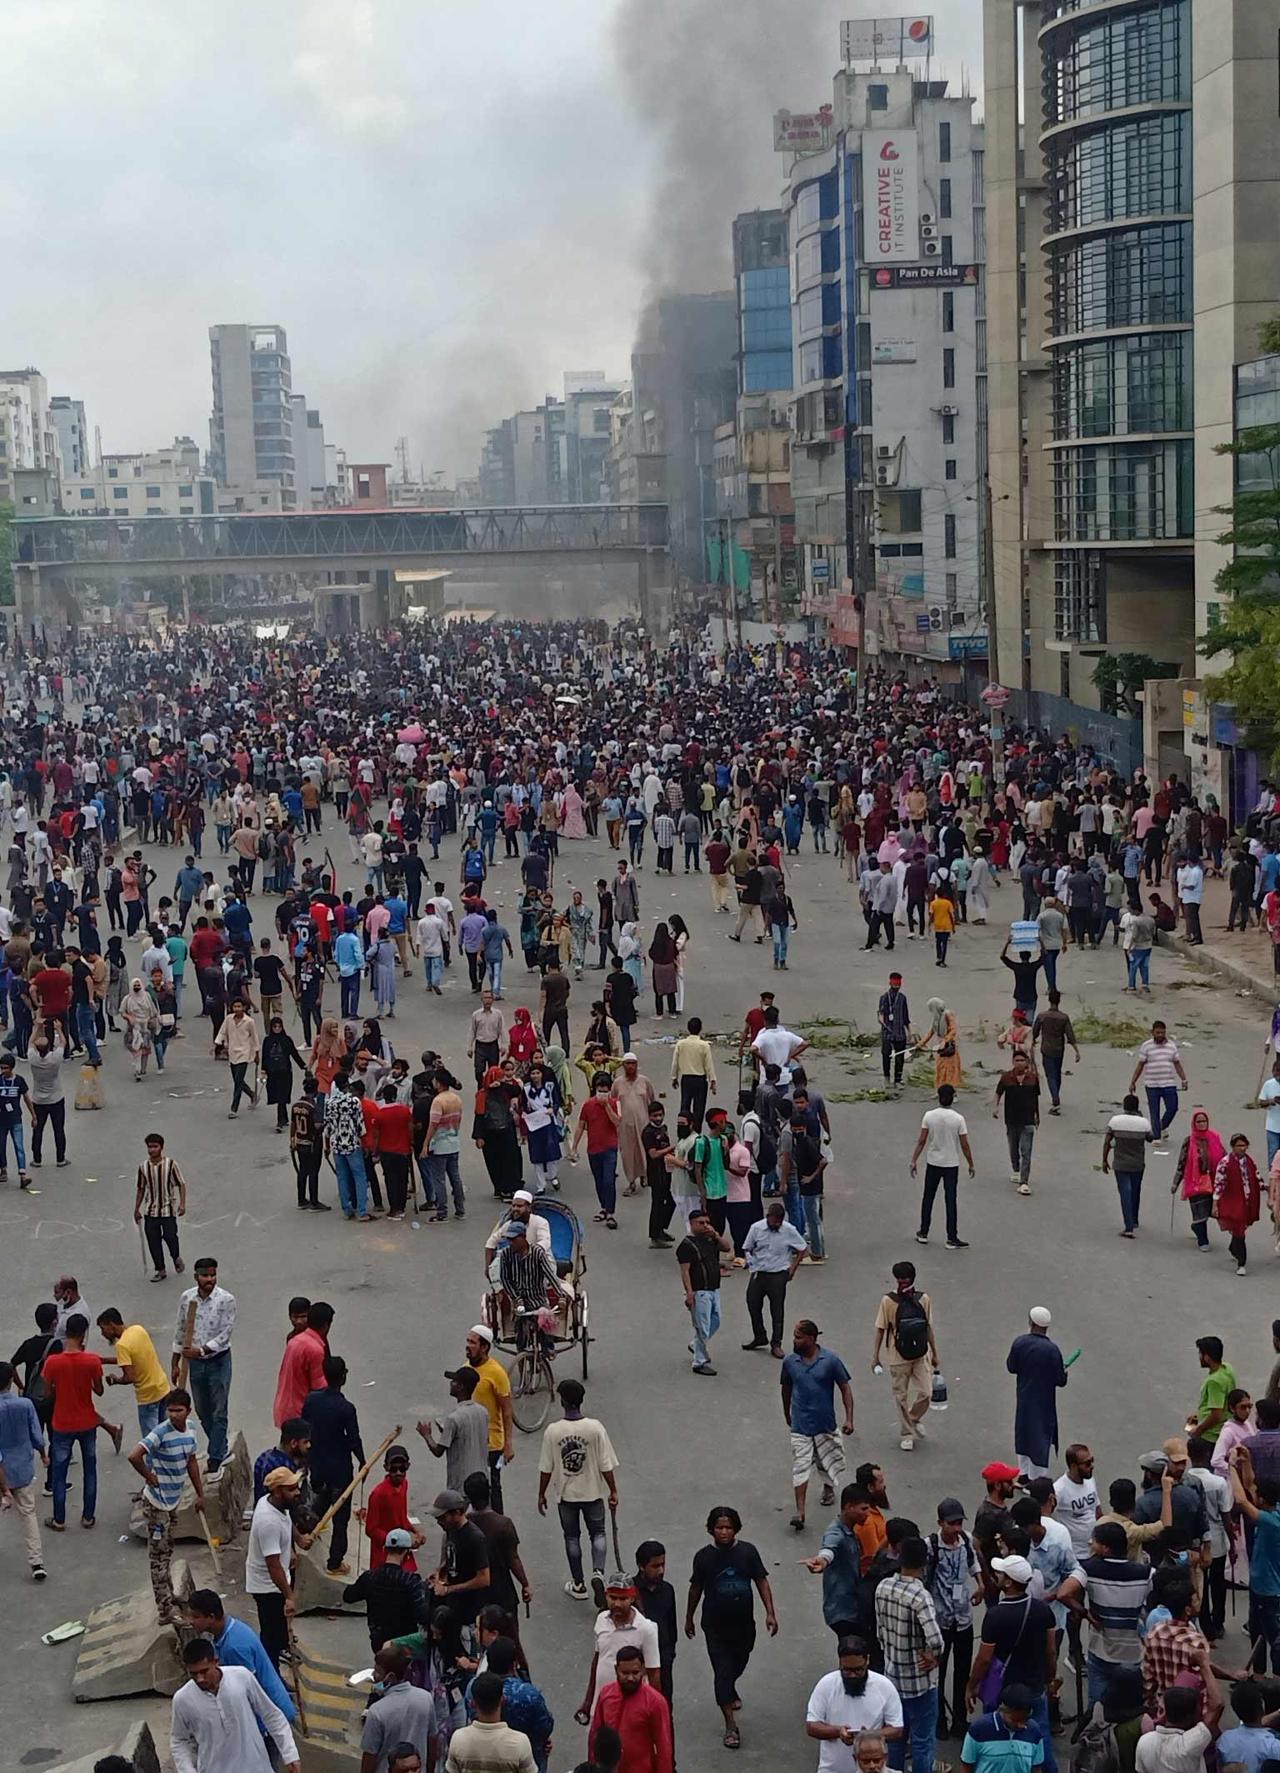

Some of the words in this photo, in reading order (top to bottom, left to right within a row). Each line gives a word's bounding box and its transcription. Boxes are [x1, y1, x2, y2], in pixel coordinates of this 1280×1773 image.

[878, 167, 892, 254] CREATIVE
[893, 167, 904, 238] INSTITUTE
[894, 243, 905, 253] IT
[899, 268, 920, 278] Pan
[920, 268, 935, 277] De
[936, 266, 959, 276] Asia
